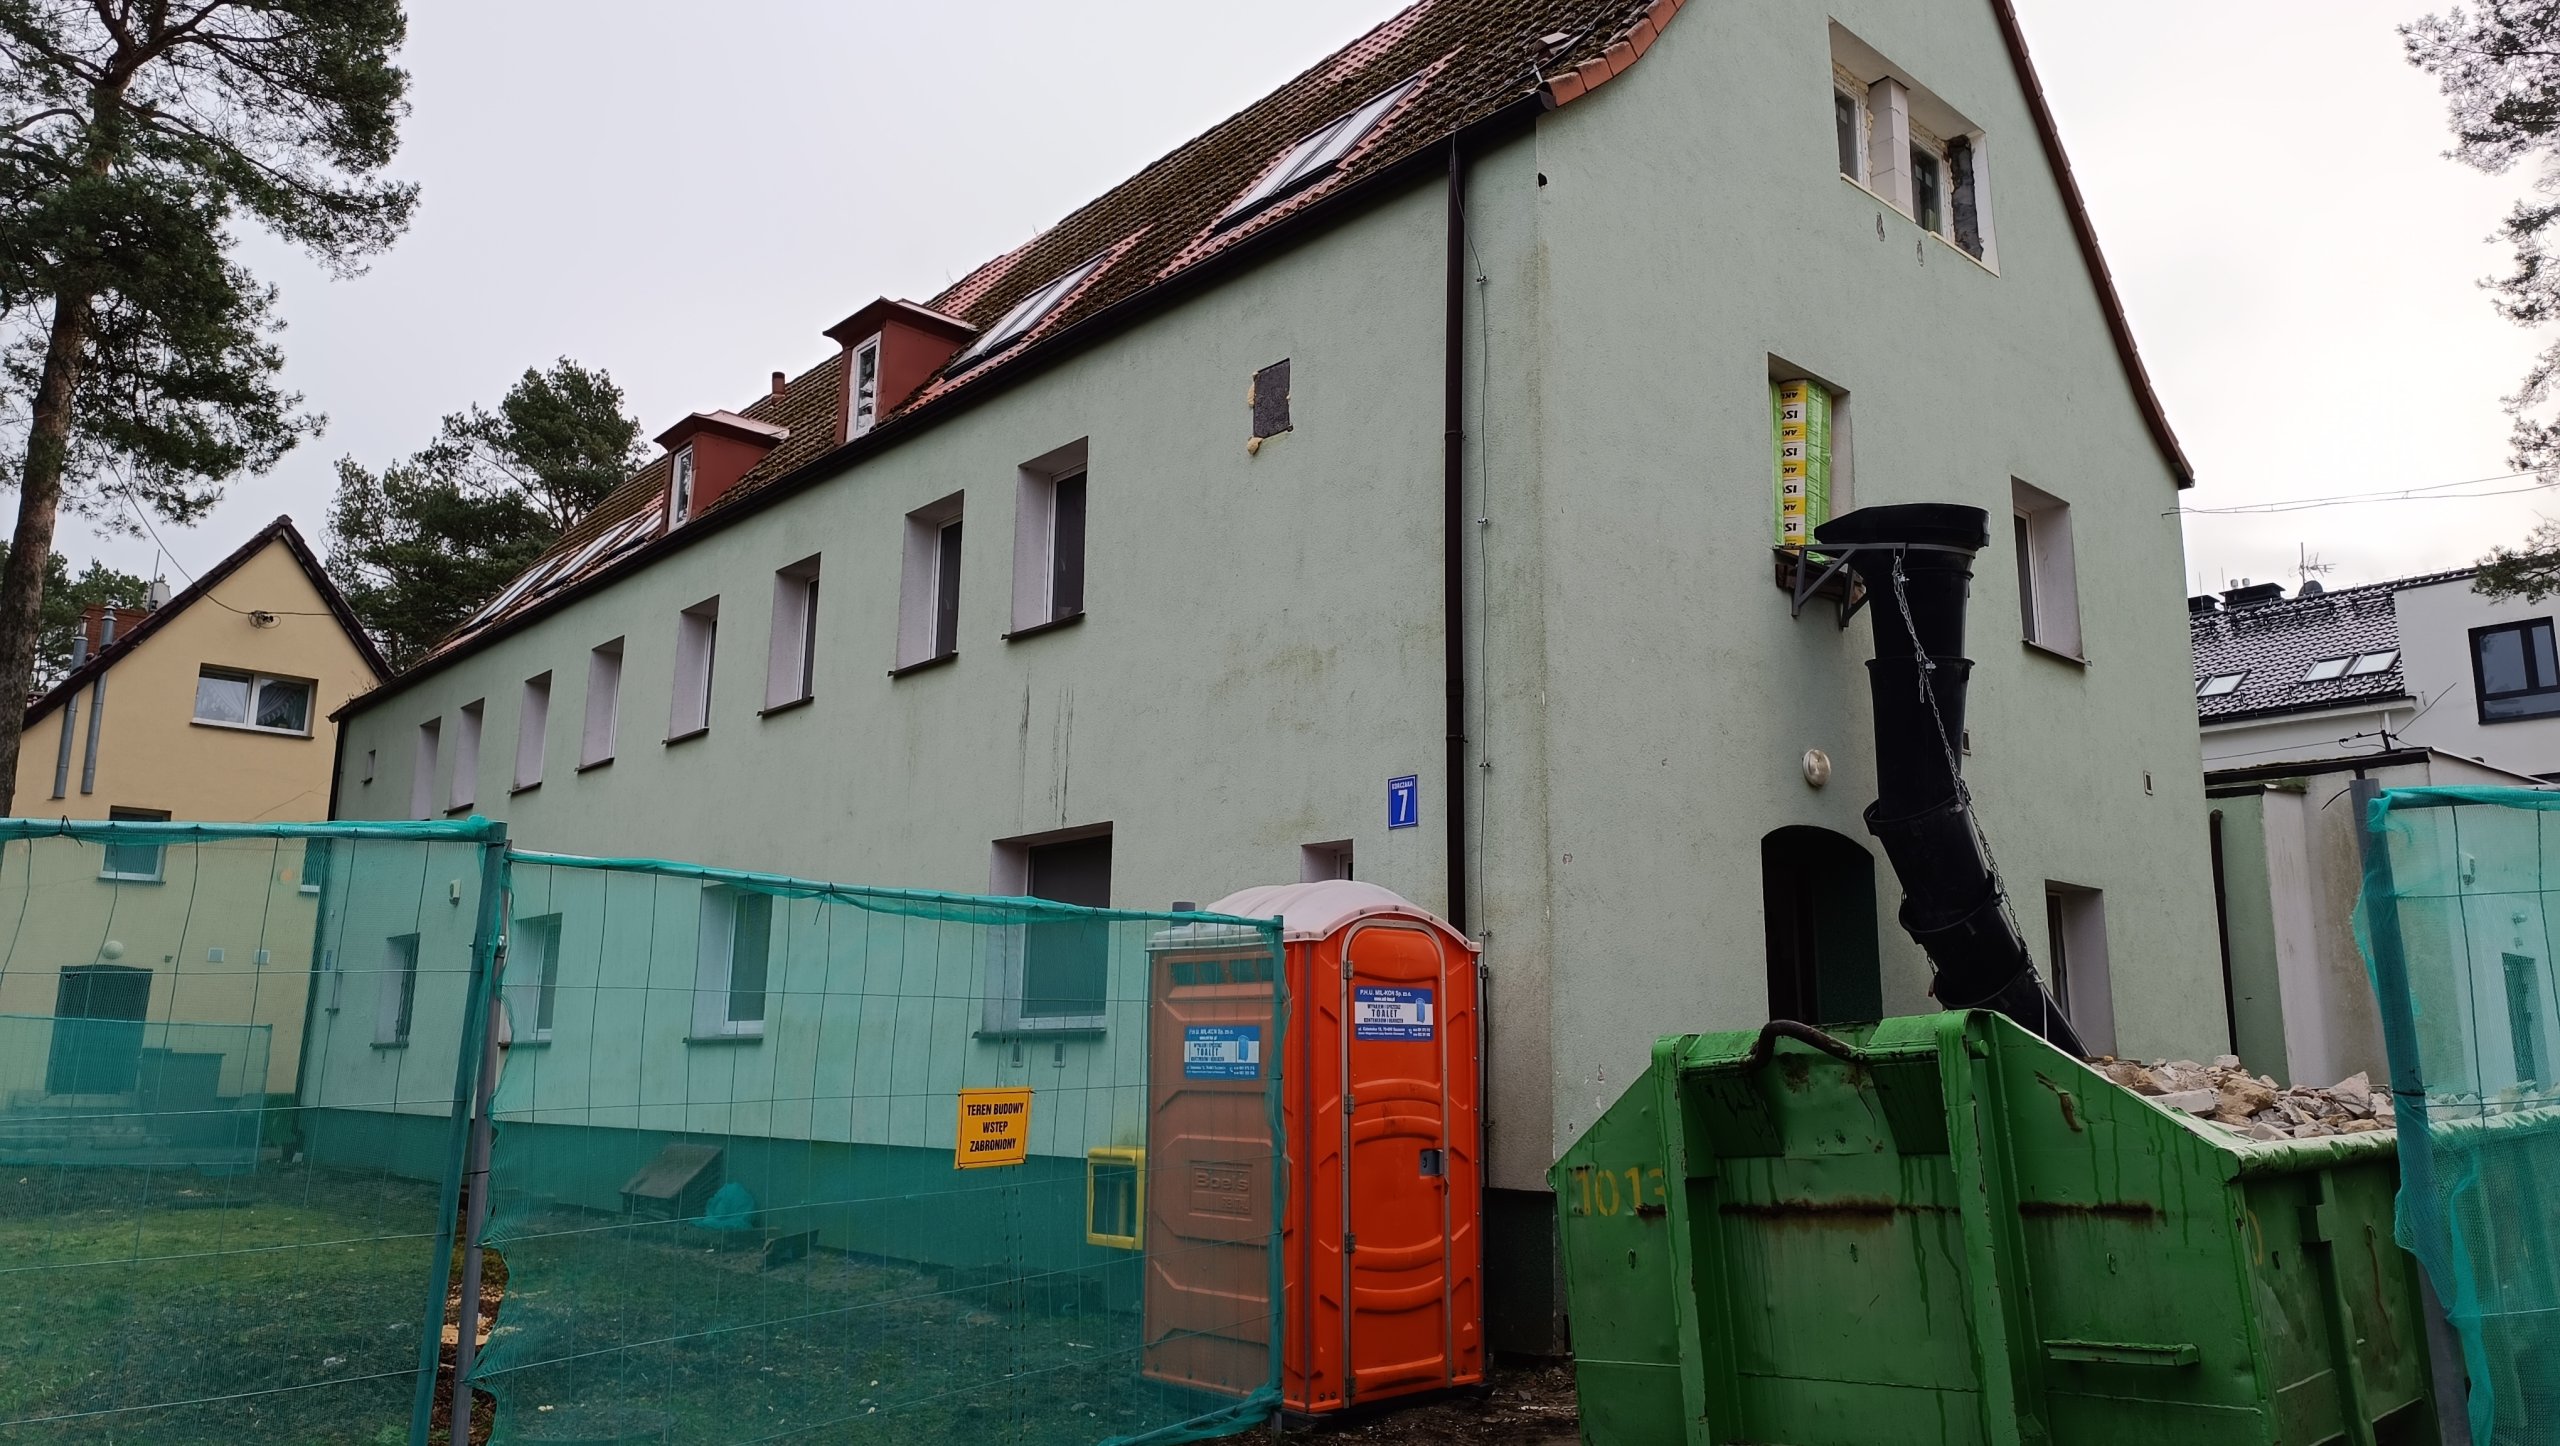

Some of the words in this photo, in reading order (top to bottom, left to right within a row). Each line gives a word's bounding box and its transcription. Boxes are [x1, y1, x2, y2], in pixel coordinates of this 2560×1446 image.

[1783, 485, 1797, 493] IS
[1398, 789, 1408, 821] 7
[967, 1104, 992, 1116] TEREN
[993, 1103, 1024, 1115] BUDOWY
[983, 1121, 1008, 1135] WSTĘP
[970, 1138, 1016, 1152] ZABRONIONY
